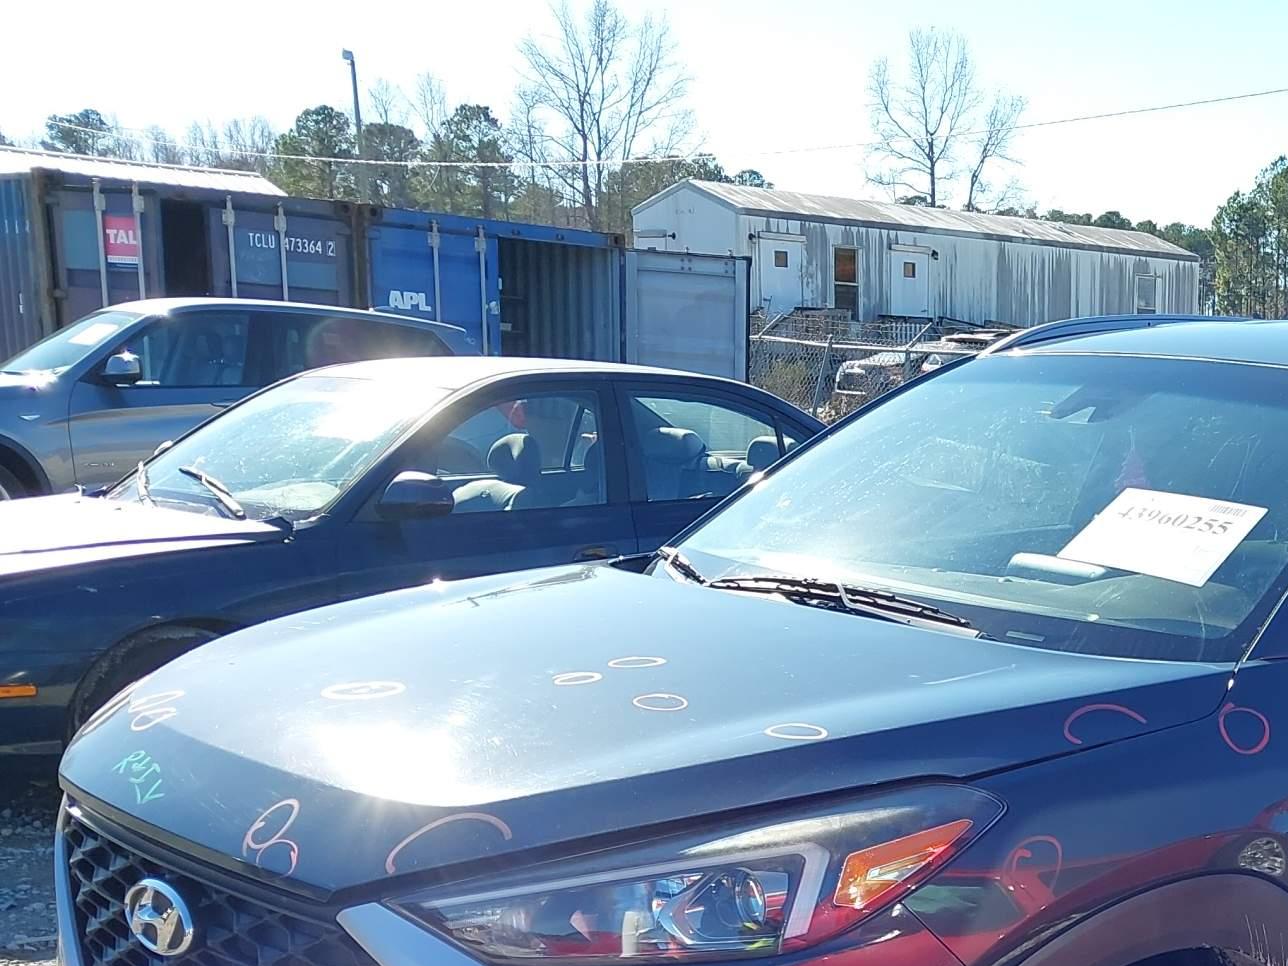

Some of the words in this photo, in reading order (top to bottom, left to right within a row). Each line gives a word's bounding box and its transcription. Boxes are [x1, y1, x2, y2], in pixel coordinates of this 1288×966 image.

[105, 228, 137, 245] TAL
[248, 231, 276, 249] TCLU
[284, 236, 322, 255] 473364
[327, 240, 336, 257] 2
[388, 289, 432, 312] APL
[1118, 505, 1234, 535] 43960255
